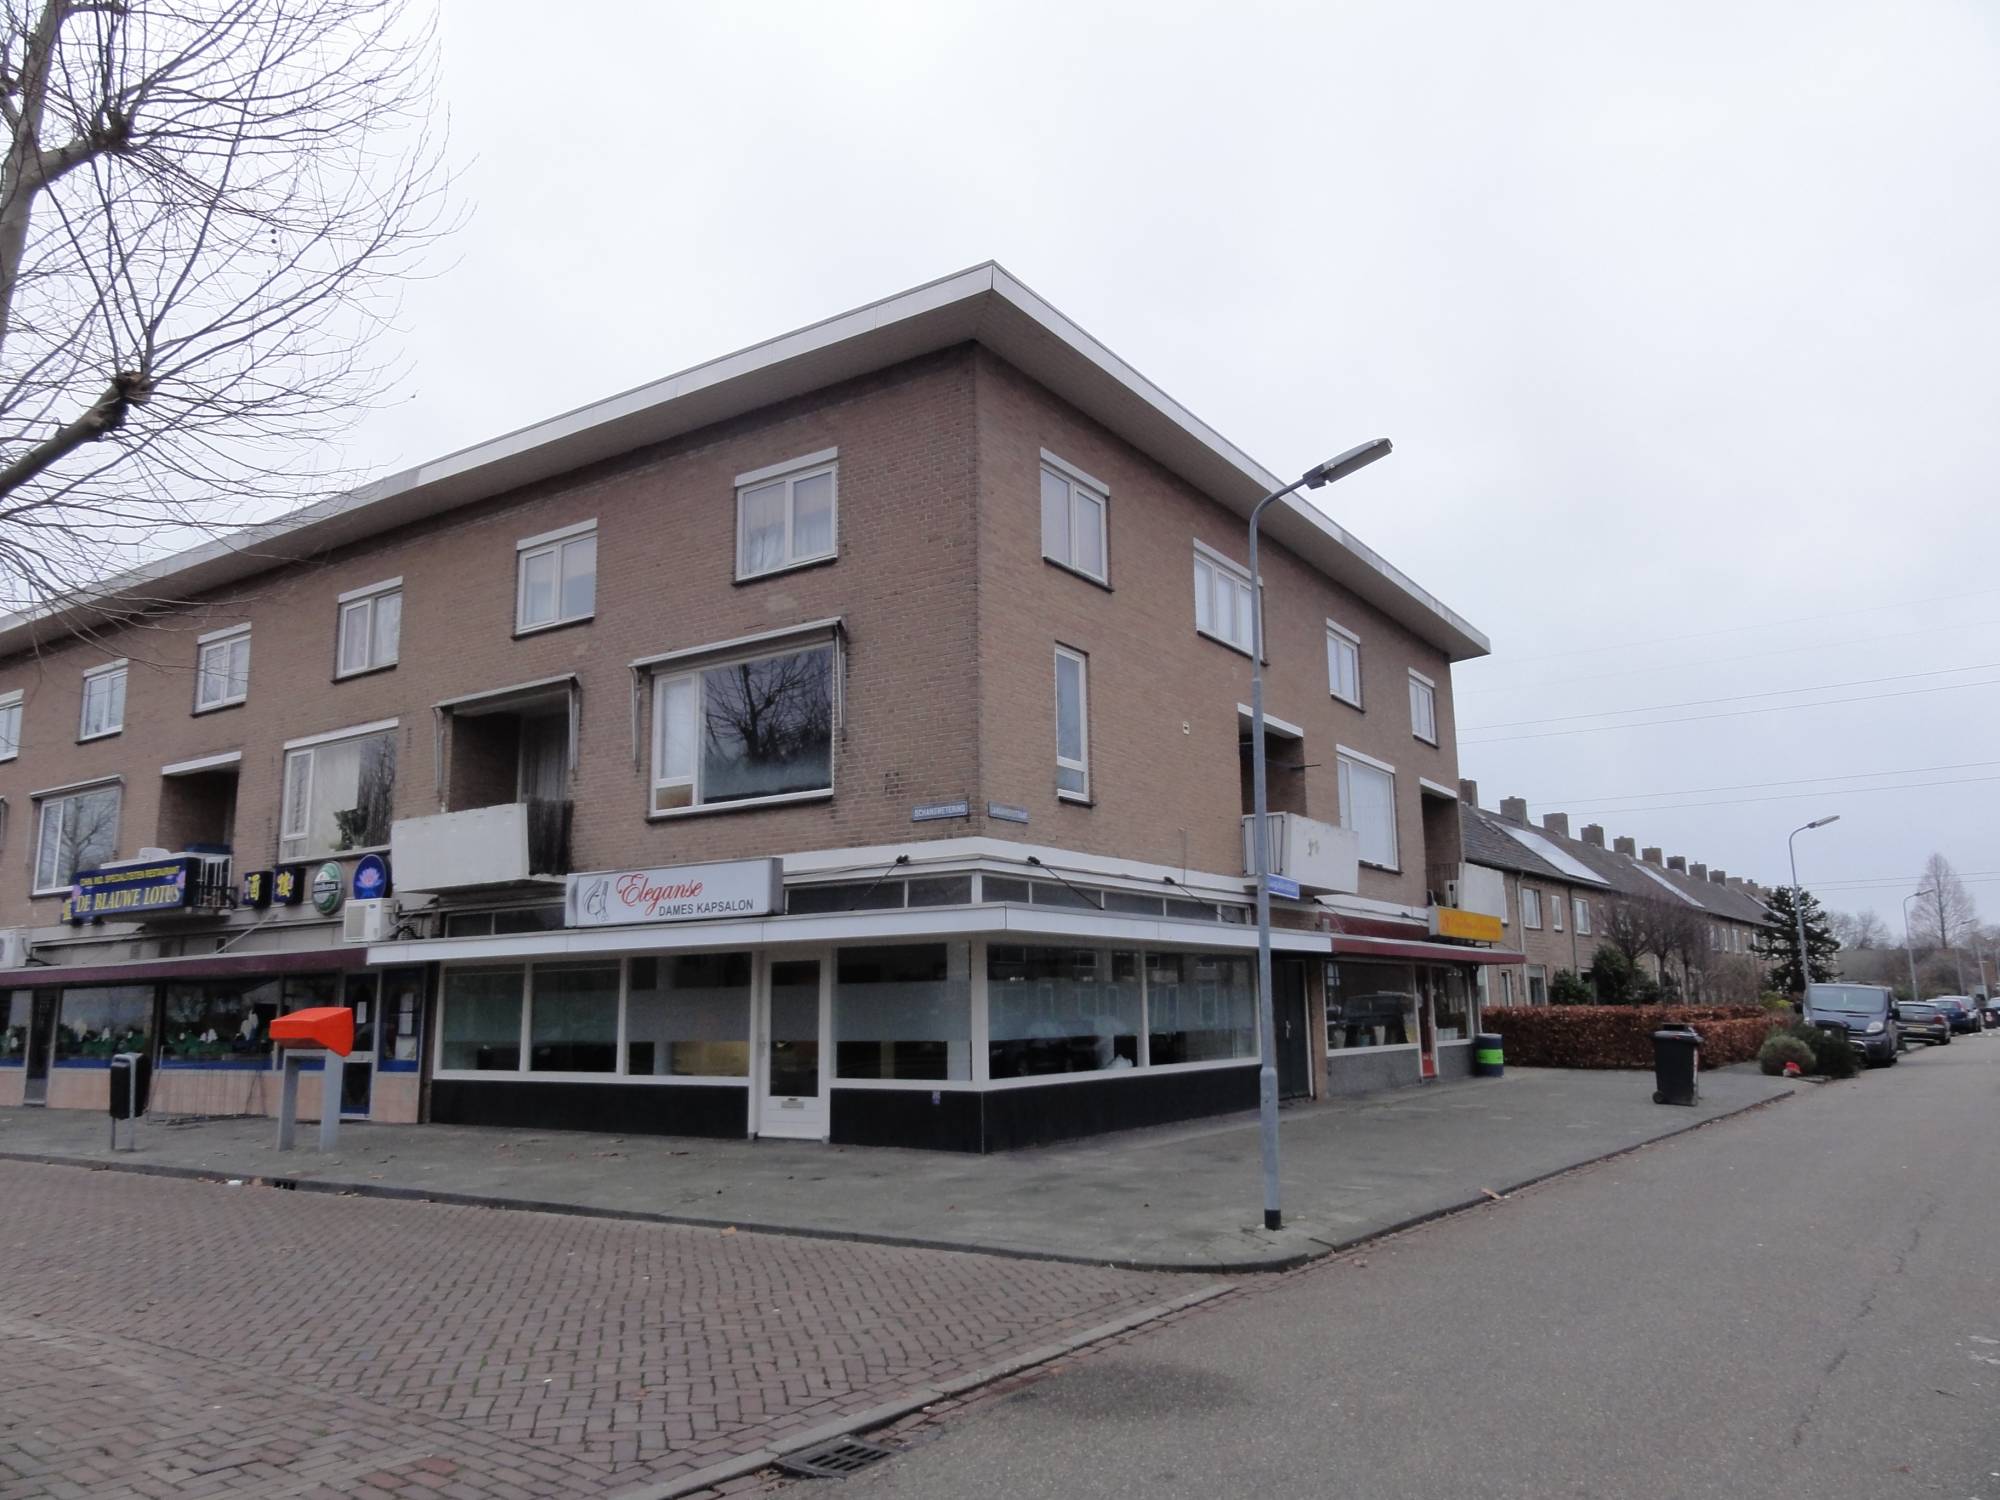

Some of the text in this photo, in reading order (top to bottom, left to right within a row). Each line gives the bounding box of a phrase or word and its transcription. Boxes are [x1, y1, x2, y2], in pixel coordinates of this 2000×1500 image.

[75, 894, 91, 913] DE
[94, 888, 142, 911] BLAUWE
[143, 884, 180, 905] LOTUS
[616, 873, 703, 917] Eleganse
[659, 899, 753, 917] DAMES KAPSALON
